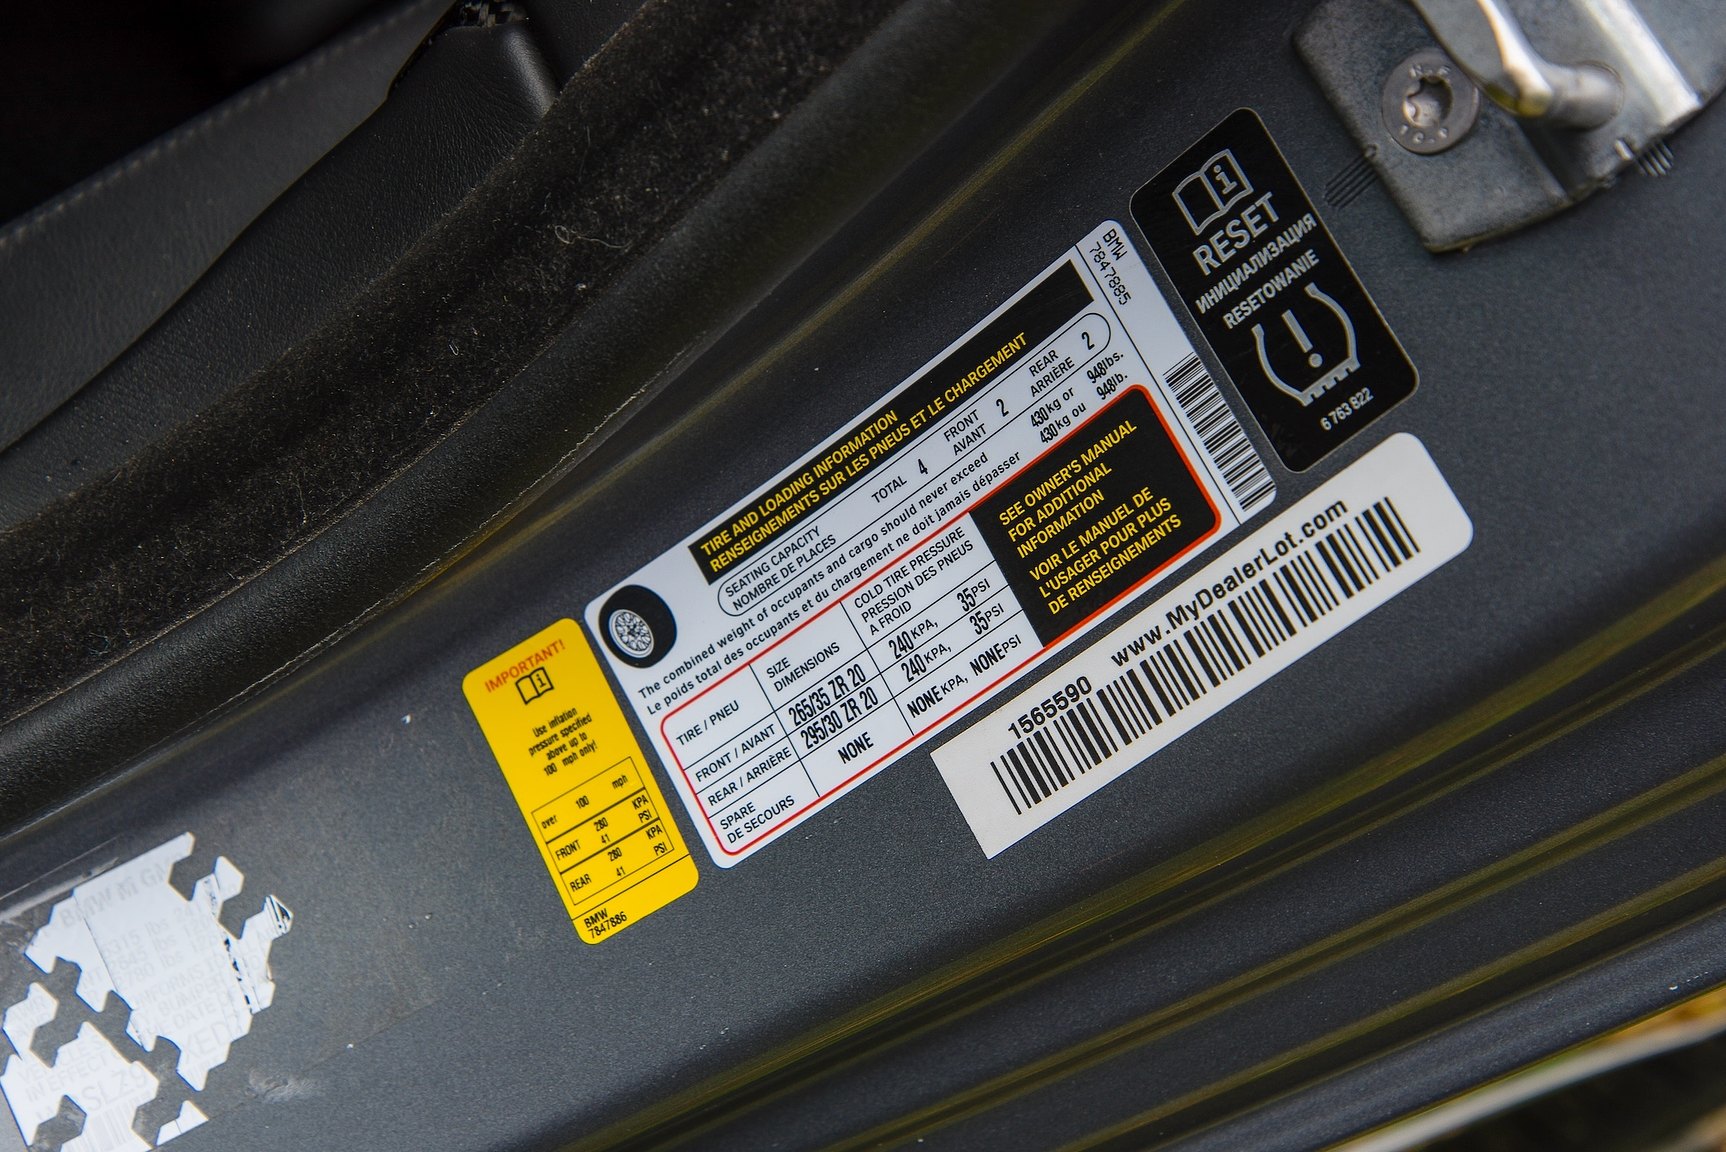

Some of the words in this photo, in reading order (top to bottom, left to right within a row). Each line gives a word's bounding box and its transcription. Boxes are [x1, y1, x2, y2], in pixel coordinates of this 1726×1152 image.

[1101, 227, 1128, 261] BMW
[1191, 190, 1280, 276] RESET
[1088, 240, 1132, 306] 7847885
[1194, 212, 1317, 314] ИНИЦИАЛИЗАЦИЯ
[1222, 248, 1320, 329] RESETOWANIE
[1028, 349, 1059, 377] REAR
[1080, 331, 1095, 351] 2
[1029, 355, 1075, 398] ARRIÈRE
[942, 408, 979, 442] FRONT
[995, 397, 1010, 418] 2
[709, 489, 820, 572] RENSEIGNEMENTS
[818, 470, 847, 496] SUR
[844, 453, 870, 477] LES
[868, 422, 911, 460] PNEUS
[908, 408, 927, 430] ET
[926, 396, 946, 416] LE
[944, 331, 1027, 403] CHARGEMENT
[952, 422, 987, 456] AVANT
[699, 529, 733, 556] TIRE
[731, 510, 759, 537] AND
[757, 471, 815, 517] LOADING
[812, 409, 898, 479] INFORMATION
[870, 475, 908, 503] TOTAL
[917, 457, 929, 475] 4
[998, 500, 1026, 526] SEE
[1023, 458, 1082, 507] OWNER'S
[1079, 419, 1137, 466] MANUAL
[1007, 516, 1037, 542] FOR
[1036, 462, 1112, 524] ADDITIONAL
[1016, 488, 1105, 559] INFORMATION
[637, 681, 661, 699] The
[662, 642, 716, 685] combined
[716, 617, 756, 648] weight
[756, 606, 769, 622] of
[770, 570, 825, 613] occupants
[825, 552, 847, 574] and
[847, 532, 879, 558] cargo
[879, 502, 918, 536] should
[917, 481, 948, 509] never
[949, 451, 989, 486] exceed
[1061, 386, 1074, 401] or
[646, 701, 662, 715] Le
[663, 680, 695, 707] poids
[694, 660, 723, 684] total
[723, 647, 744, 666] des
[745, 609, 800, 651] occupants
[800, 598, 814, 613] et
[814, 588, 830, 603] du
[830, 542, 895, 592] chargement
[894, 532, 910, 547] ne
[911, 513, 936, 536] doit
[933, 488, 972, 522] jamais
[971, 450, 1021, 492] dépasser
[1071, 402, 1087, 418] ou
[1028, 552, 1063, 581] VOIR
[1060, 539, 1080, 560] LE
[1077, 502, 1135, 547] MANUEL
[1131, 486, 1154, 508] DE
[1038, 548, 1102, 598] L'USAGER
[1099, 521, 1139, 555] POUR
[1135, 497, 1172, 529] PLUS
[724, 561, 771, 598] SEATING
[770, 524, 820, 566] CAPACITY
[731, 572, 781, 611] NOMBRE
[778, 561, 797, 579] DE
[795, 533, 837, 568] PLACES
[853, 583, 884, 609] COLD
[882, 564, 911, 588] TIRE
[908, 525, 966, 571] PRESSURE
[860, 580, 915, 623] PRESSION
[913, 565, 938, 587] DES
[936, 539, 974, 571] PNEUS
[1047, 593, 1069, 615] DE
[1066, 513, 1182, 601] RENSEIGNEMENTS
[1110, 500, 1348, 667] www.MyDealerLot.com
[869, 623, 880, 636] A
[877, 600, 912, 629] FROID
[484, 638, 566, 693] IMPORTANT!
[765, 656, 791, 679] SIZE
[773, 641, 840, 693] DIMENSIONS
[887, 630, 915, 660] 240
[900, 653, 927, 683] 240
[787, 686, 831, 727] 265/35
[826, 674, 851, 701] ZR
[846, 662, 867, 688] 20
[799, 709, 843, 750] 295/30
[839, 697, 863, 723] ZR
[858, 685, 879, 711] 20
[1007, 675, 1092, 740] 1565590
[527, 732, 560, 757] pressure
[559, 712, 593, 738] specified
[532, 724, 548, 738] Use
[547, 707, 578, 729] inflation
[545, 742, 568, 761] above
[567, 736, 579, 748] up
[578, 731, 588, 742] to
[675, 723, 703, 746] TIRE
[708, 699, 740, 726] PNEU
[542, 761, 558, 776] 100
[561, 751, 579, 767] mph
[578, 739, 598, 757] only!
[694, 751, 732, 783] FRONT
[740, 722, 775, 754] AVANT
[707, 781, 739, 807] REAR
[745, 745, 792, 783] ARRIÈRE
[540, 814, 558, 830] over
[574, 794, 590, 809] 100
[611, 774, 629, 789] mph
[592, 816, 609, 832] 280
[631, 793, 649, 810] KPA
[600, 832, 611, 844] 41
[637, 808, 653, 824] PSI
[719, 801, 756, 830] SPARE
[726, 826, 745, 844] DE
[743, 794, 795, 833] SECOURS
[554, 838, 581, 861] FRONT
[606, 846, 623, 862] 280
[644, 823, 663, 840] KPA
[615, 865, 626, 877] 41
[652, 841, 668, 856] PSI
[568, 872, 592, 892] REAR
[583, 907, 608, 929] BMW
[587, 910, 628, 939] 7847886
